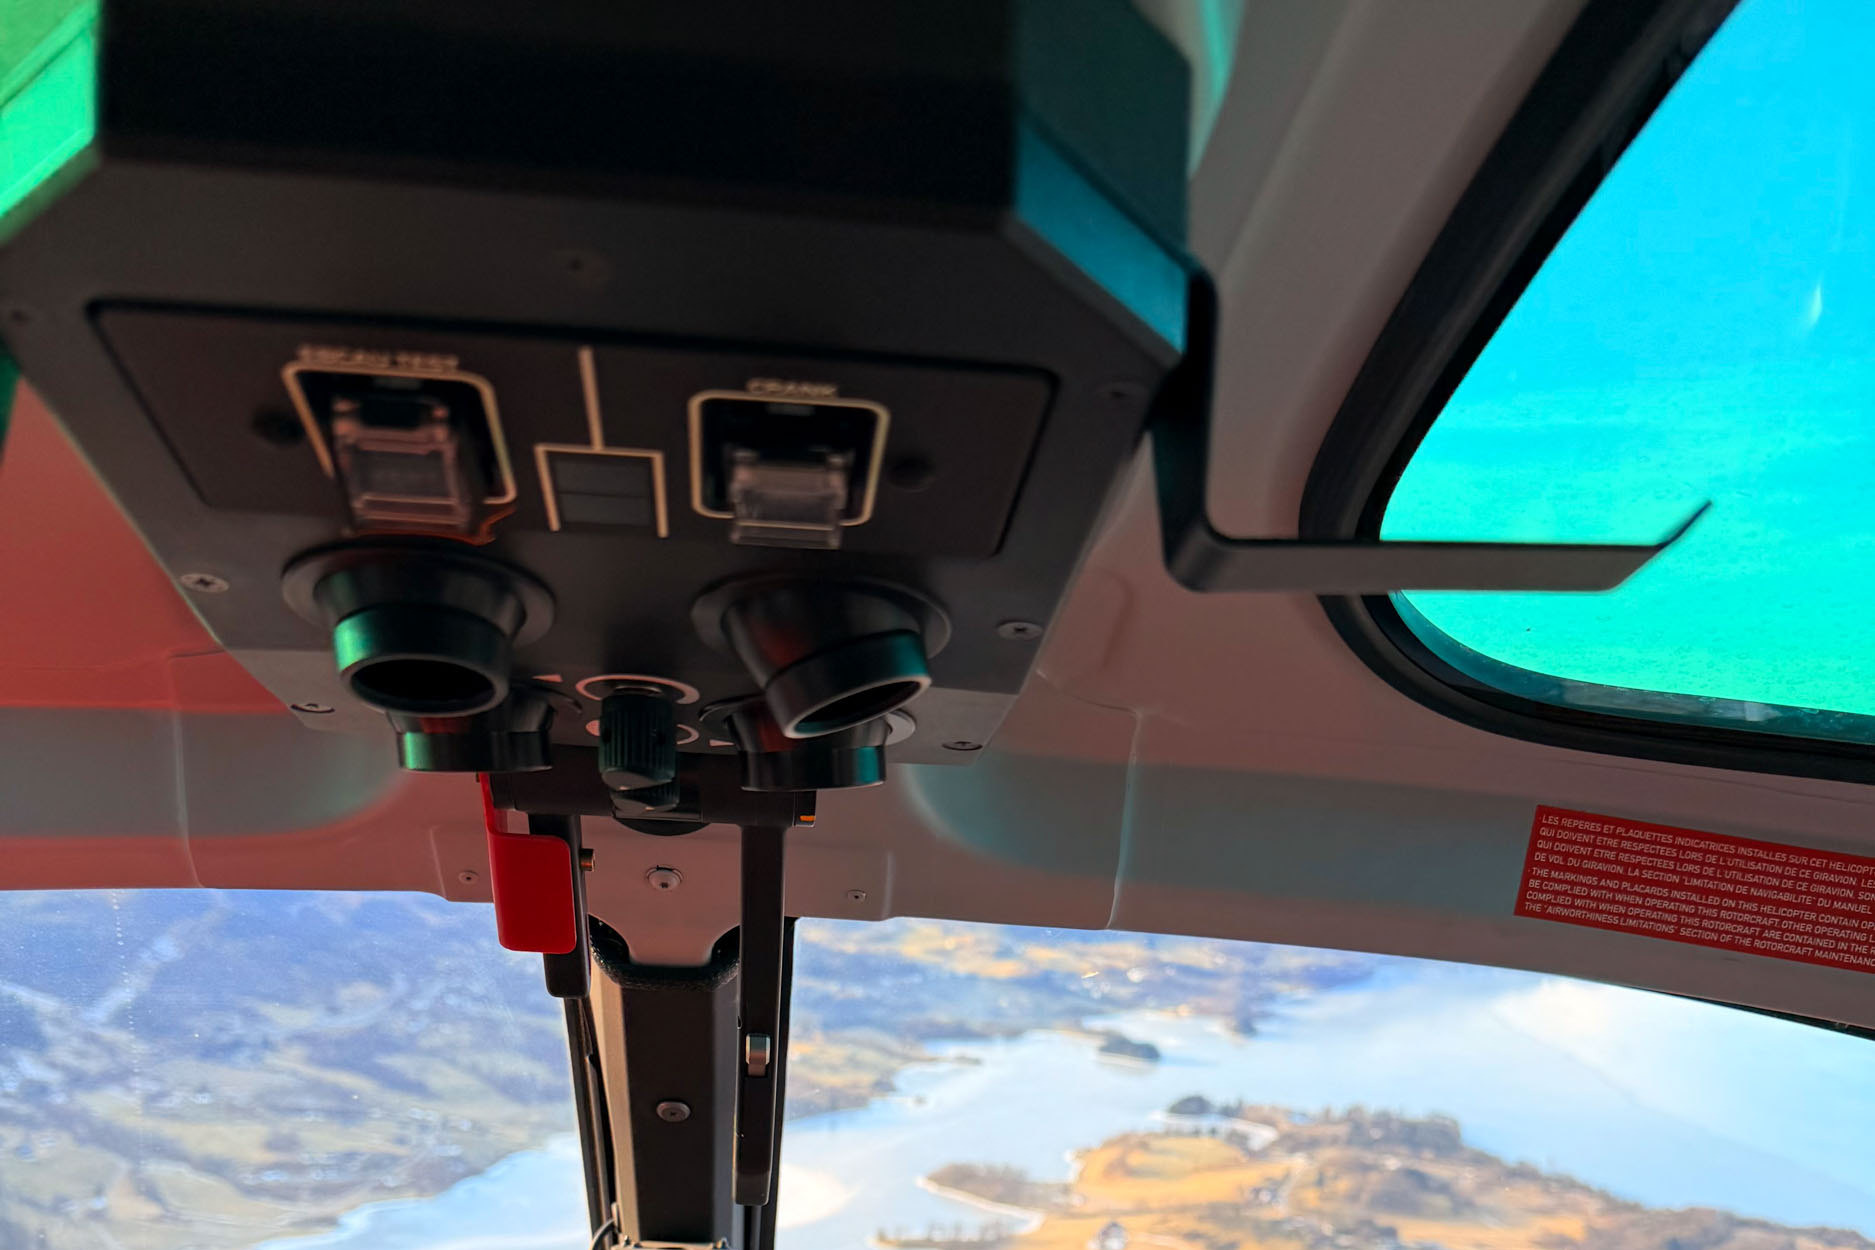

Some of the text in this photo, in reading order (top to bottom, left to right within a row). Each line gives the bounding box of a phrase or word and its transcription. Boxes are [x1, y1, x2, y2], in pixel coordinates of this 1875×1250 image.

[1537, 840, 1552, 849] QUI
[1554, 843, 1593, 855] DOIVENT
[1594, 849, 1616, 860] ETRE
[1618, 853, 1674, 869] RESPECTEES
[1677, 863, 1700, 873] LORS
[1703, 867, 1715, 876] DE
[1782, 879, 1794, 888] DE
[1796, 882, 1809, 891] CE
[1540, 827, 1554, 837] QUI
[1557, 830, 1595, 843] DOIVENT
[1597, 837, 1619, 847] ETRE
[1621, 841, 1677, 857] RESPECTEES
[1679, 850, 1702, 861] LORS
[1705, 854, 1717, 863] DE
[1784, 867, 1797, 876] DE
[1799, 869, 1812, 878] CE
[1542, 814, 1875, 875] LES REPERES ET PLAQUETTES INDICATRICES INSTALLES SUR CET HELICOPT
[1529, 879, 1540, 888] BE
[1543, 881, 1588, 896] COMPLIED
[1591, 889, 1613, 899] WITH
[1615, 892, 1642, 903] WHEN
[1645, 898, 1695, 913] OPERATING
[1698, 906, 1718, 916] THIS
[1782, 921, 1813, 932] OTHER
[1815, 926, 1866, 941] OPERATING
[1532, 867, 1549, 877] THE
[1551, 870, 1597, 885] MARKINGS
[1600, 879, 1619, 888] AND
[1622, 881, 1668, 897] PLACARDS
[1671, 890, 1720, 905] INSTALLED
[1722, 899, 1736, 908] ON
[1738, 901, 1758, 911] THIS
[1760, 905, 1816, 920] HELICOPTER
[1819, 914, 1858, 928] CONTAIN
[1535, 853, 1546, 861] DE
[1549, 854, 1564, 864] VOL
[1568, 857, 1580, 867] DU
[1628, 868, 1639, 876] LA
[1641, 870, 1680, 883] SECTION
[1736, 886, 1748, 894] DE
[1817, 898, 1831, 907] DU
[1833, 901, 1872, 914] MANUEL
[1525, 902, 1541, 912] THE
[1680, 928, 1718, 940] SECTION
[1720, 933, 1732, 942] OF
[1735, 936, 1752, 946] THE
[1754, 939, 1813, 956] ROTORCRAFT
[1526, 891, 1571, 905] COMPLIED
[1575, 899, 1596, 910] WITH
[1599, 903, 1626, 914] WHEN
[1628, 907, 1677, 922] OPERATING
[1680, 915, 1700, 926] THIS
[1702, 920, 1761, 936] ROTORCRAFT
[1763, 930, 1781, 940] ARE
[1784, 933, 1835, 948] CONTAINED
[1837, 942, 1848, 951] IN
[1850, 944, 1868, 954] THE
